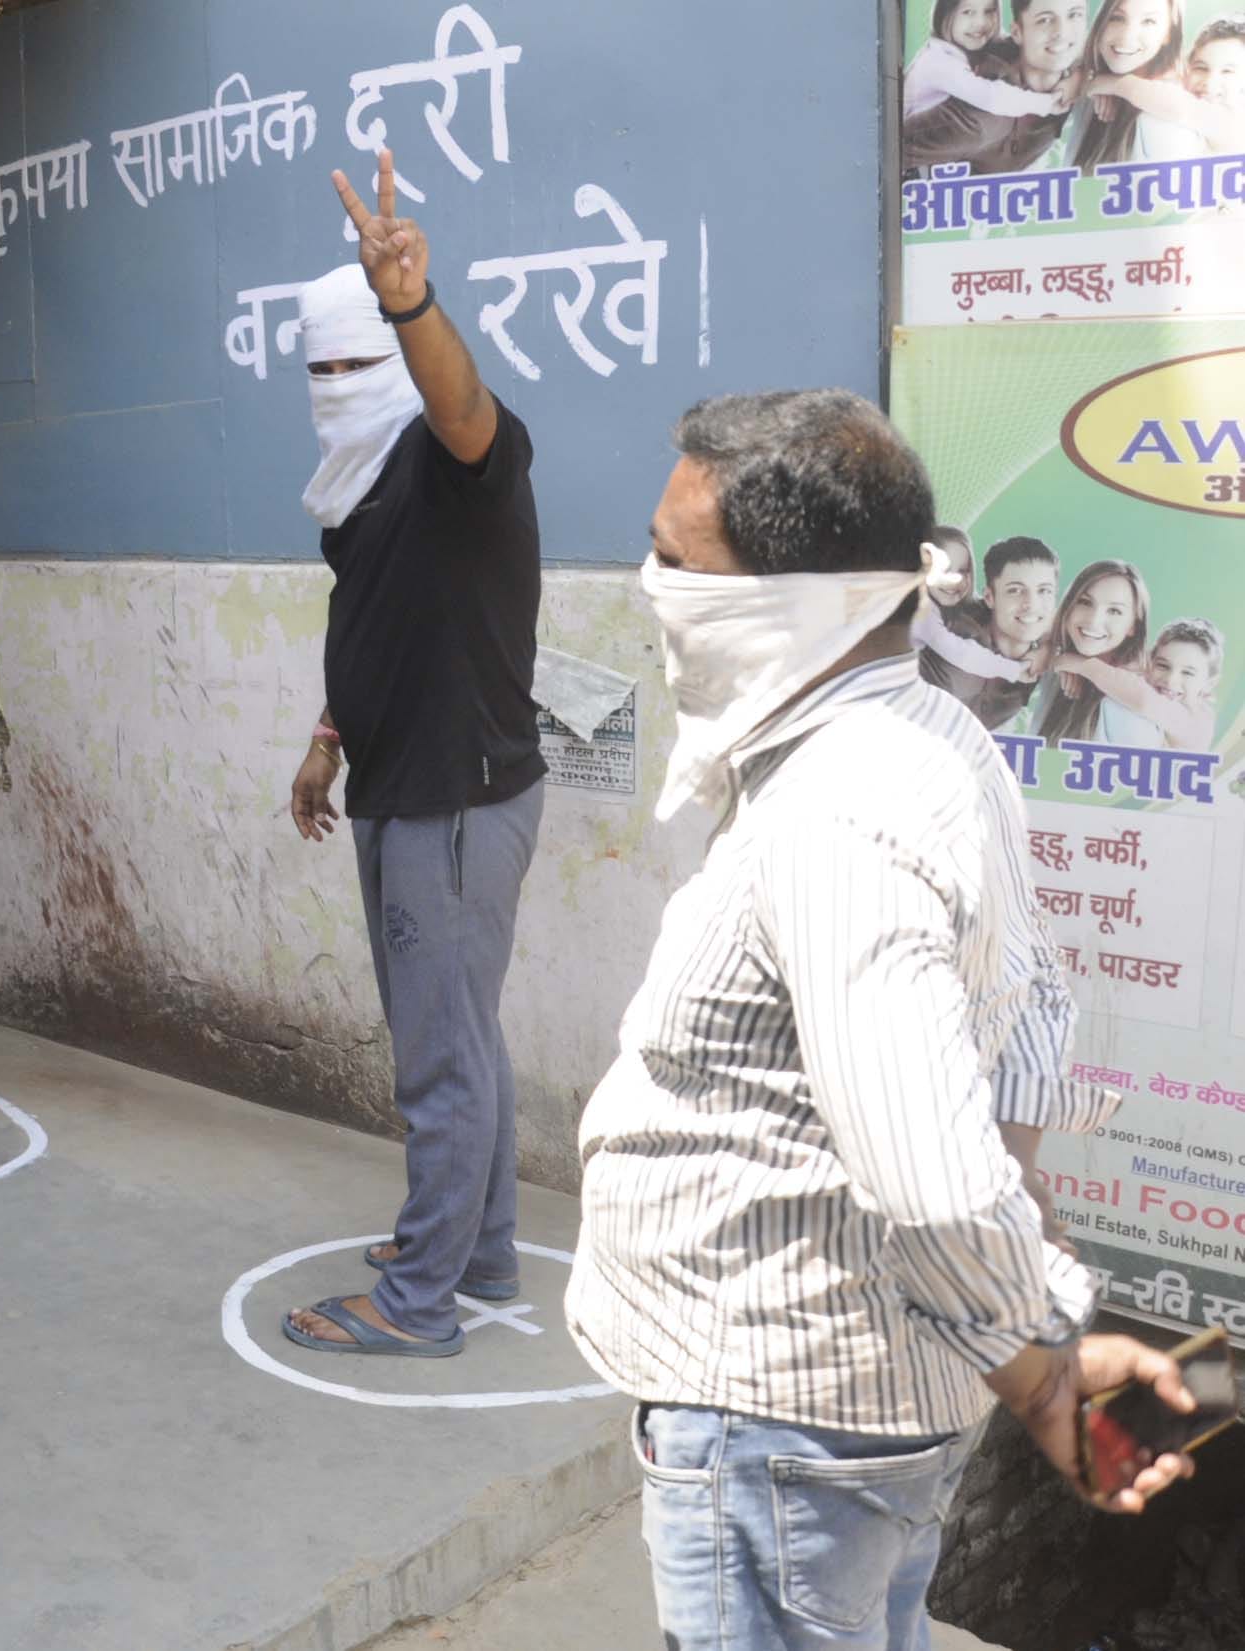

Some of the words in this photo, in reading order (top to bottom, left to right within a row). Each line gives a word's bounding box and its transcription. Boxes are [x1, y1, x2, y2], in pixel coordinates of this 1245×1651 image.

[110, 73, 317, 207] सामाजिक
[345, 4, 522, 203] दूरी
[951, 267, 1032, 310] मुरब्बा,
[1125, 246, 1193, 288] बर्फी,
[1061, 741, 1220, 804] उत्पाद
[1027, 830, 1074, 872] ड्डू,
[1085, 830, 1148, 870] बर्फी,
[1090, 888, 1143, 934] चूर्ण,
[1098, 951, 1182, 989] पाउडर
[1109, 1129, 1183, 1153] 9001:2008
[1187, 1145, 1233, 1166] (QMS)
[1095, 1215, 1152, 1245] Estate,
[1157, 1230, 1229, 1259] Sukhpal
